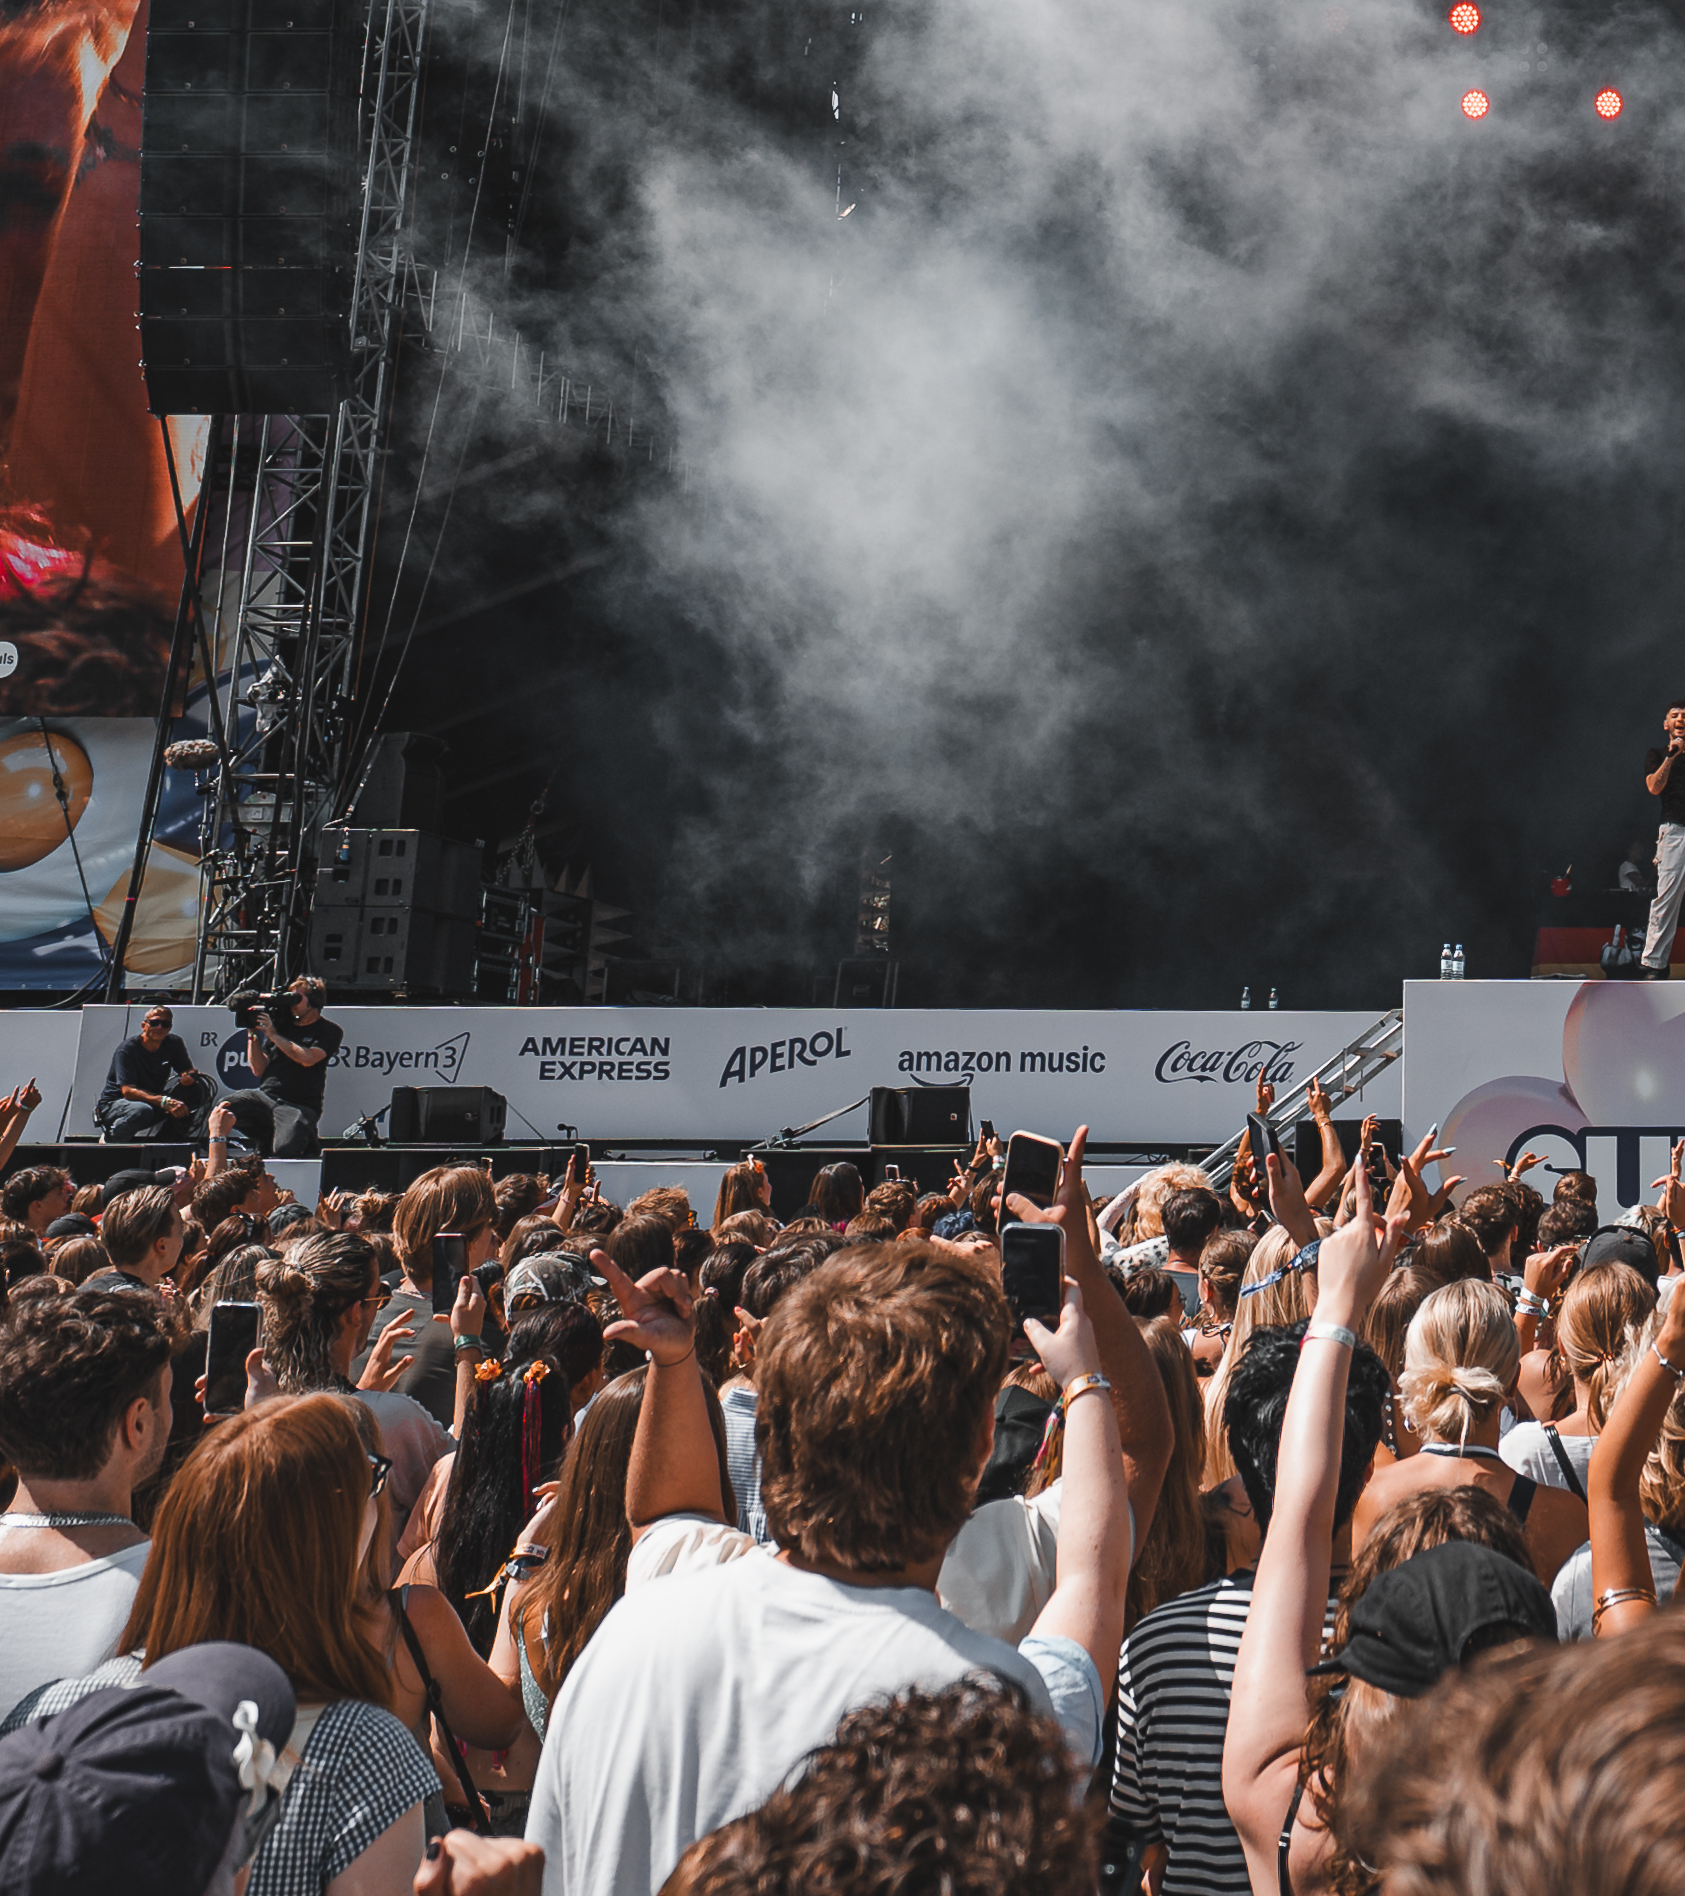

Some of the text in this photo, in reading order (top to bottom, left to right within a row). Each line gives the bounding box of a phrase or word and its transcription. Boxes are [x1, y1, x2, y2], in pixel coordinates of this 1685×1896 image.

[518, 1036, 671, 1057] AMERICAN
[719, 1027, 851, 1089] APEROL
[897, 1045, 1106, 1074] amazon music
[223, 1050, 251, 1073] pu
[538, 1060, 671, 1081] EXPRESS
[1154, 1040, 1296, 1085] Coca-Cola
